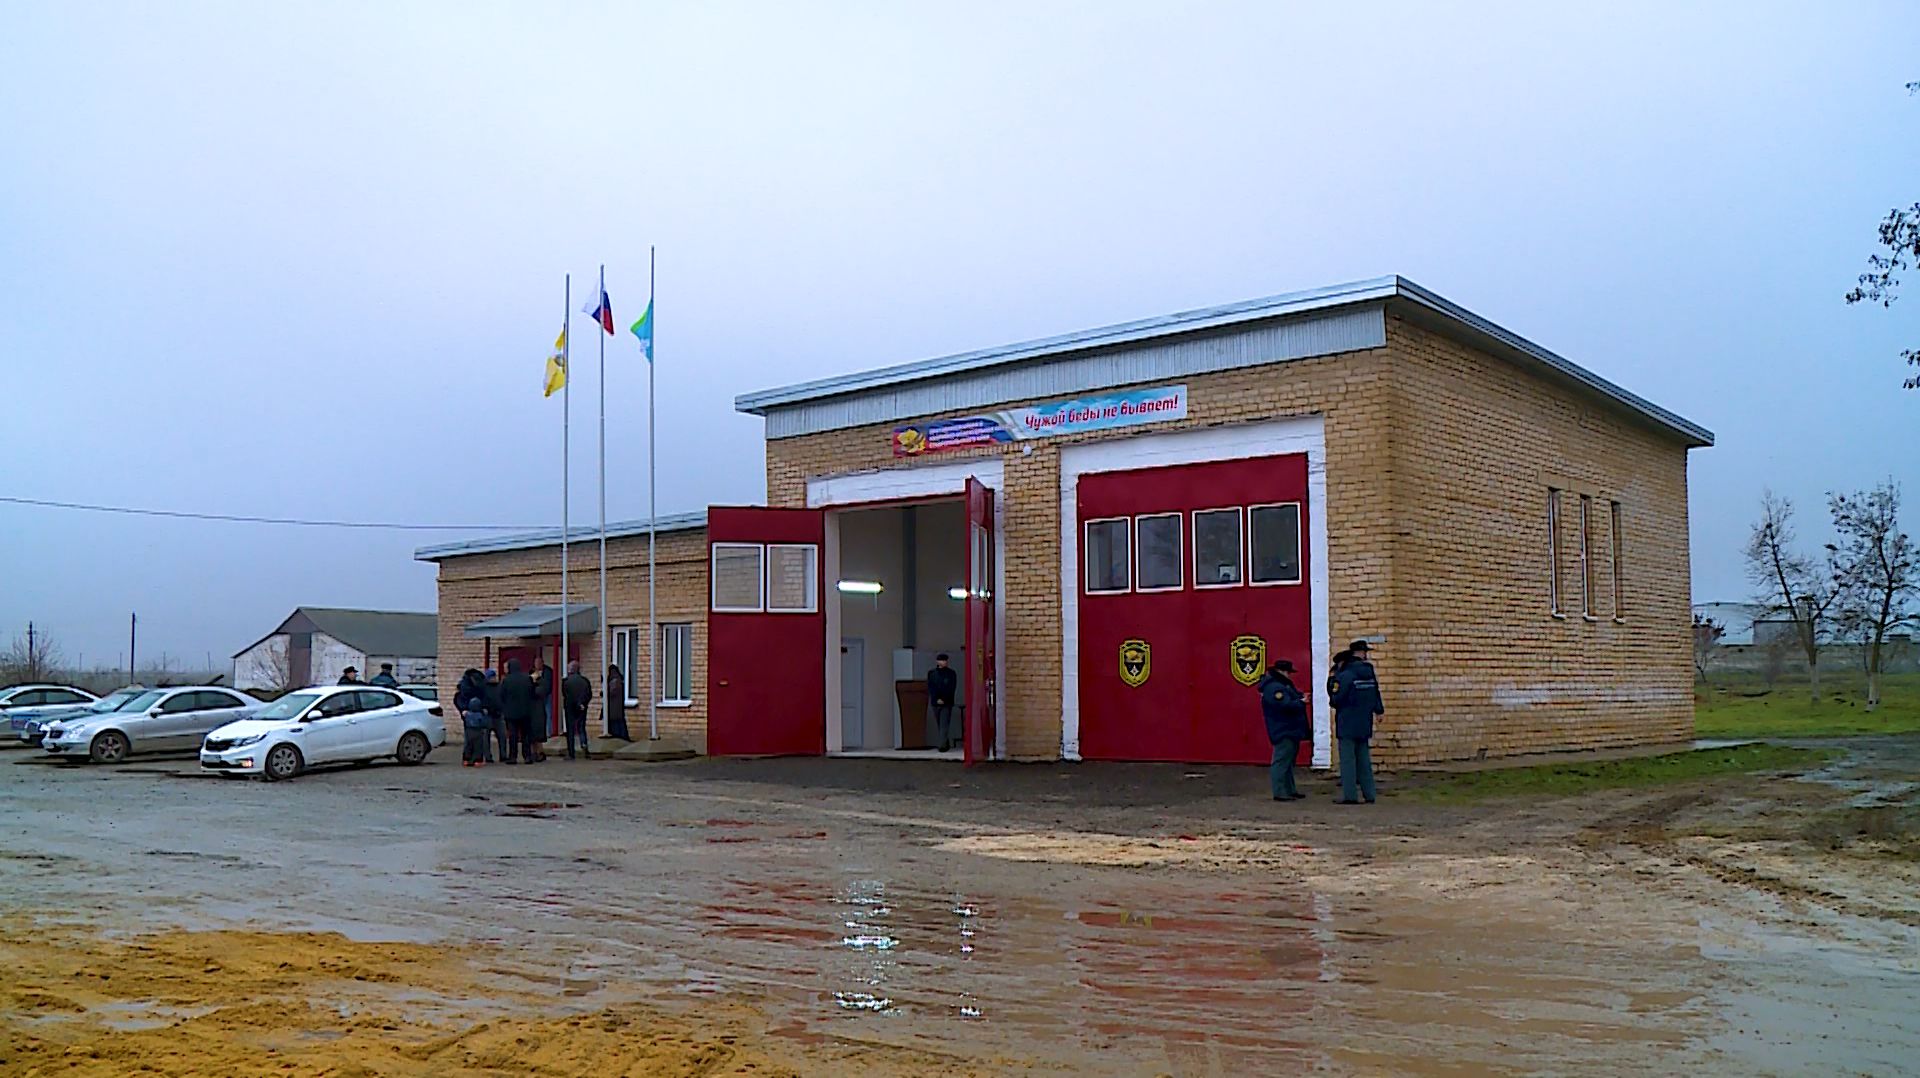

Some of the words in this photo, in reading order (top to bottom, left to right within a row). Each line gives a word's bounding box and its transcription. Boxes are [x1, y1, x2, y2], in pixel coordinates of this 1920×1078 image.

[1025, 410, 1066, 431] Чужой
[1069, 408, 1100, 423] беды
[1103, 406, 1117, 418] не
[1121, 394, 1179, 415] бывает!
